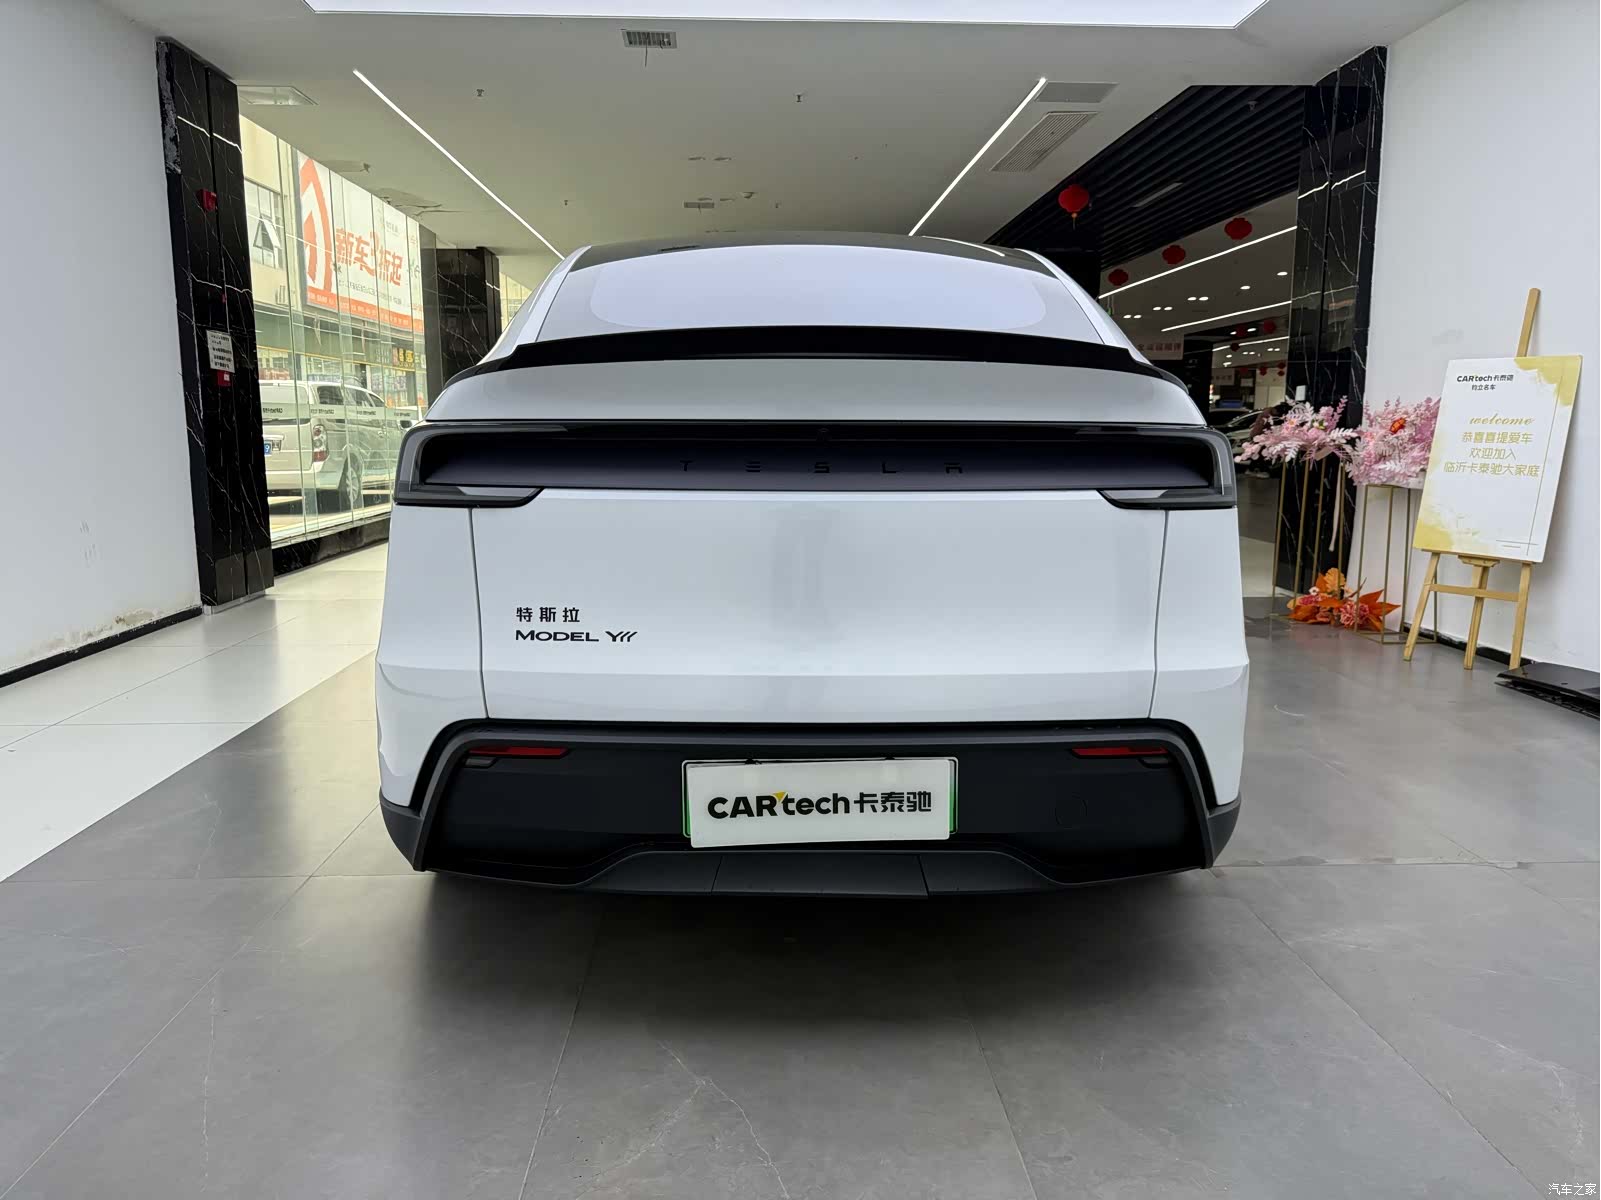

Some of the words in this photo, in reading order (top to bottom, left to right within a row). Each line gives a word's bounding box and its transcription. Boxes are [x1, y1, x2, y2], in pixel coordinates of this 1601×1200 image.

[1470, 413, 1534, 425] welcome
[1462, 432, 1533, 444] 恭喜喜提爱车
[1469, 447, 1517, 460] 欢迎加入
[680, 460, 963, 474] TESLA
[1443, 462, 1540, 477] 临沂卡泰驰大家庭
[516, 607, 580, 622] 特斯拉
[515, 630, 599, 642] MODEL
